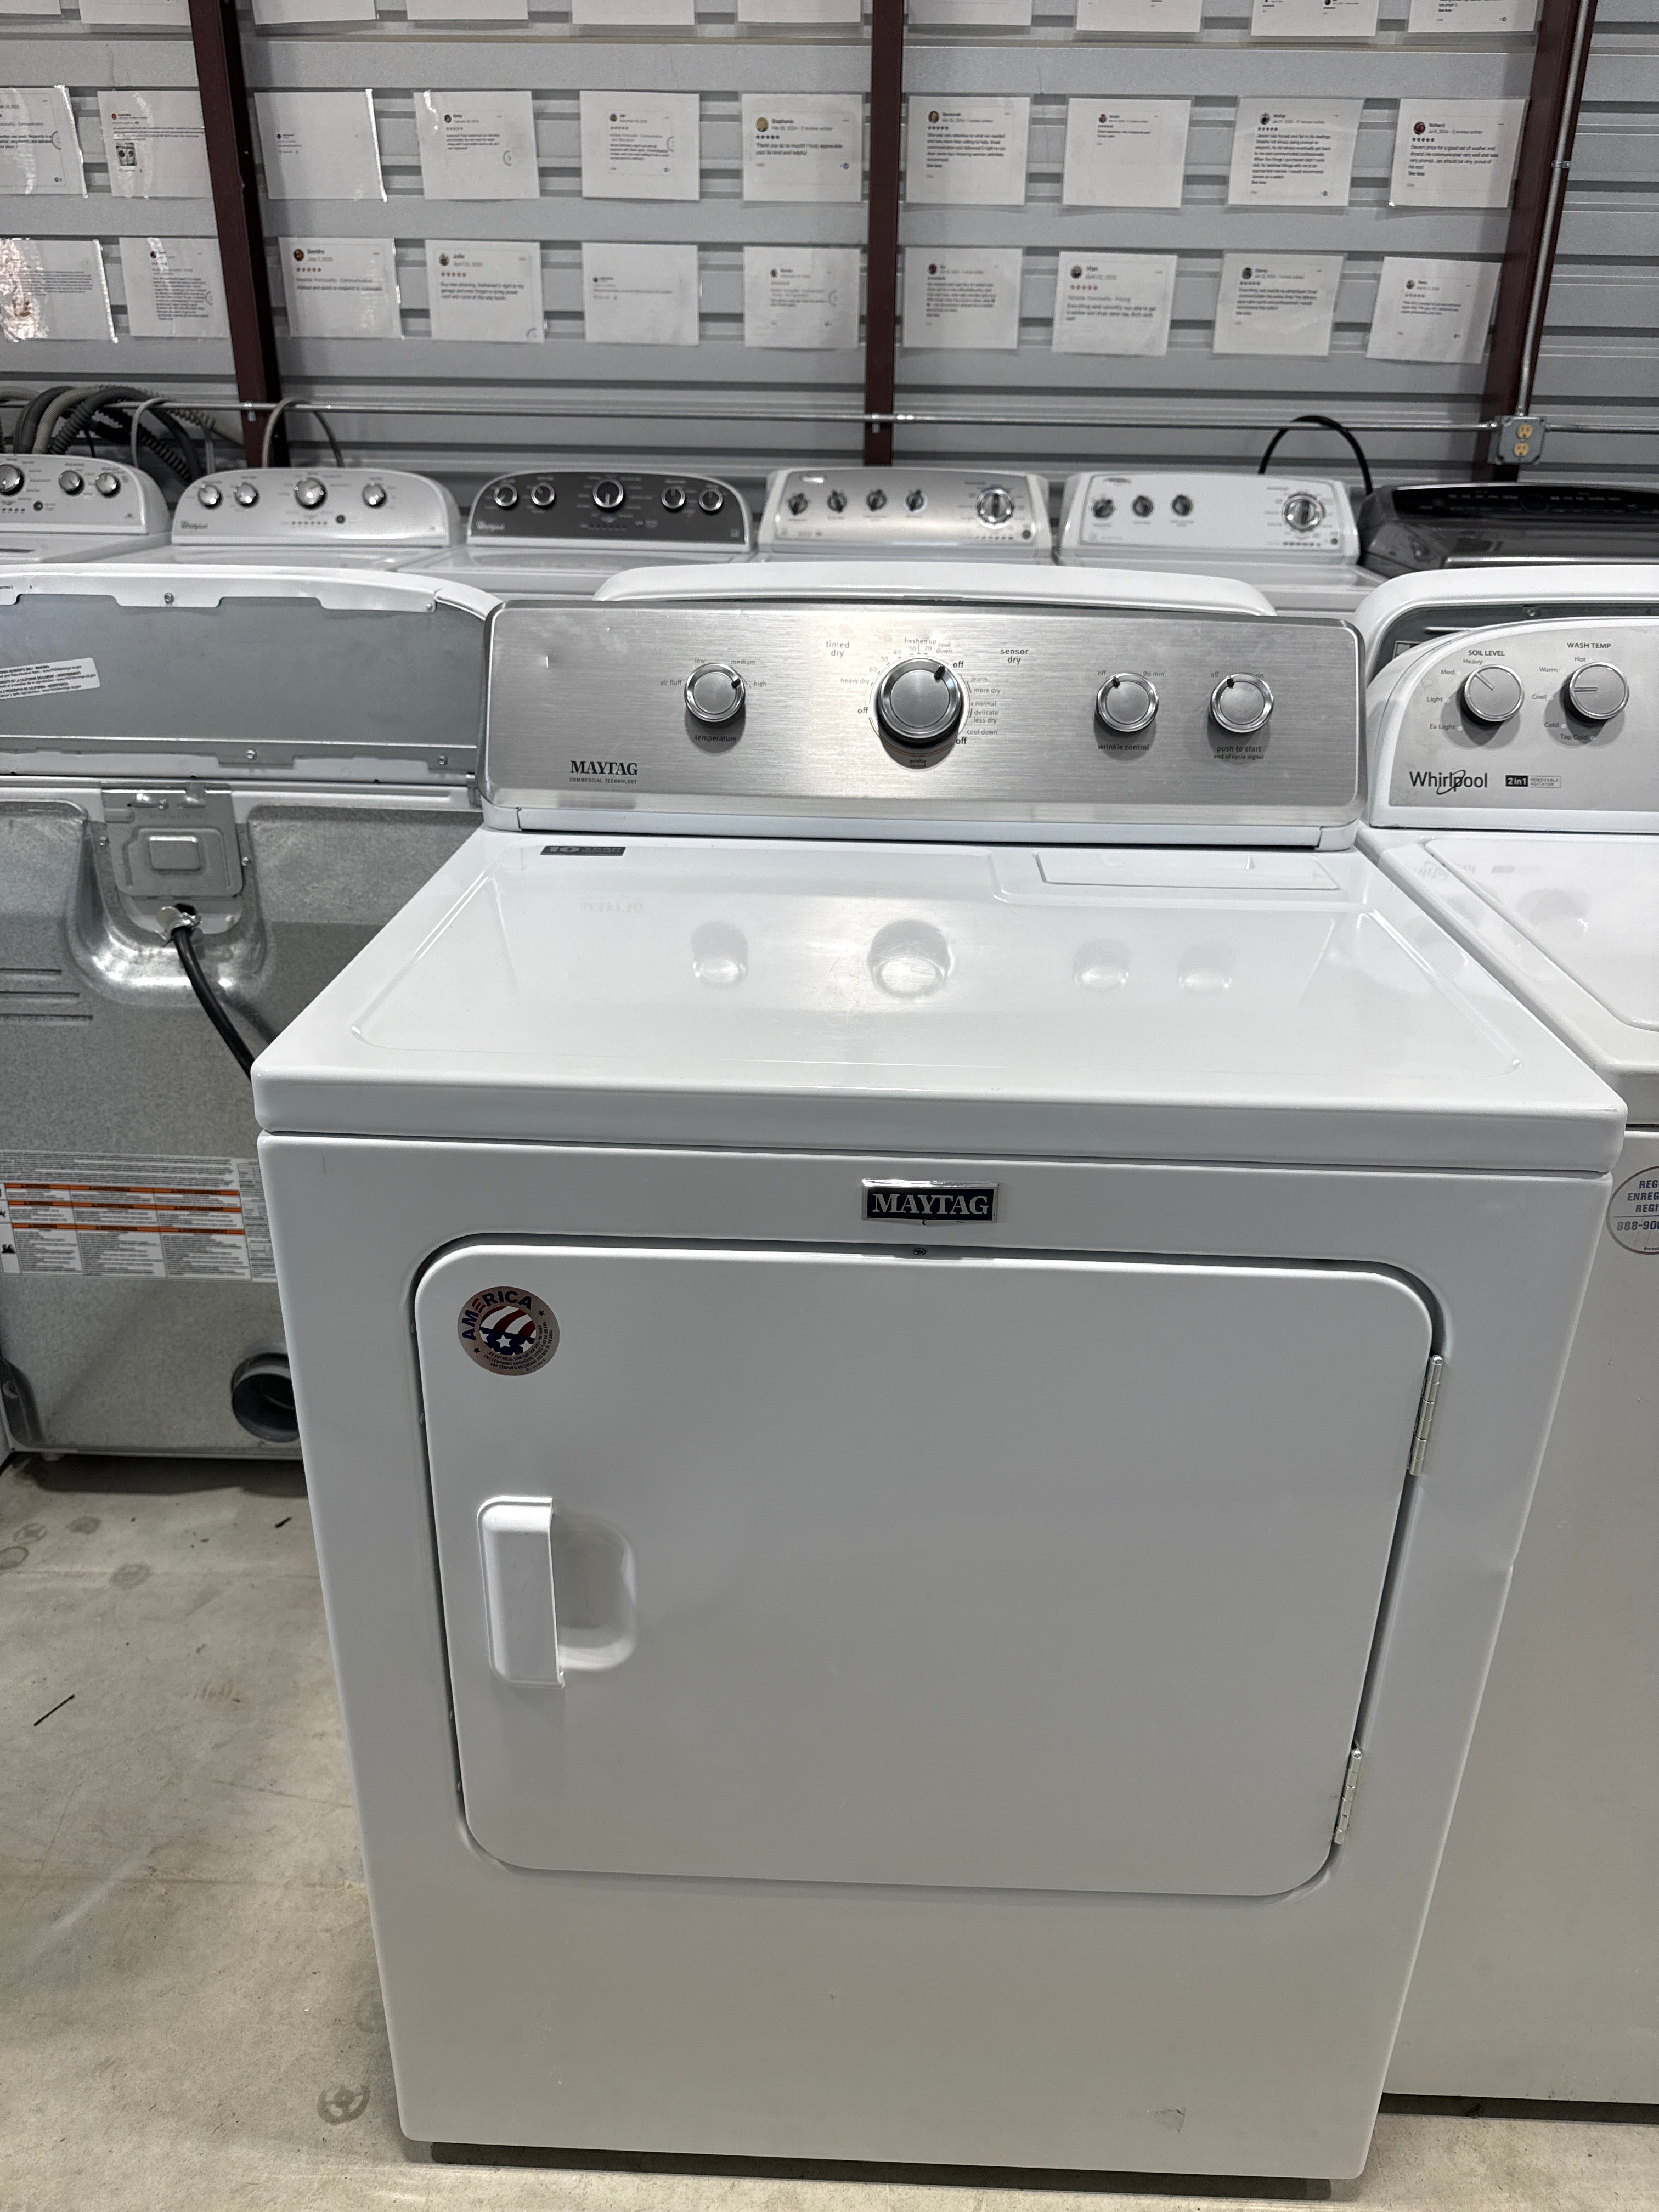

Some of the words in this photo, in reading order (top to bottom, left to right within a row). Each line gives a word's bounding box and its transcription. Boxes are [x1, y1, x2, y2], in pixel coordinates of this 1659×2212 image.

[831, 650, 844, 658] dry
[1007, 657, 1021, 665] dry
[570, 760, 639, 775] MAYTAG
[1409, 770, 1487, 795] Whirlpool
[1639, 1180, 1659, 1189] REG
[872, 1193, 989, 1215] MAYTAG
[1635, 1204, 1659, 1213] REGI
[461, 1290, 532, 1341] AMERICA
